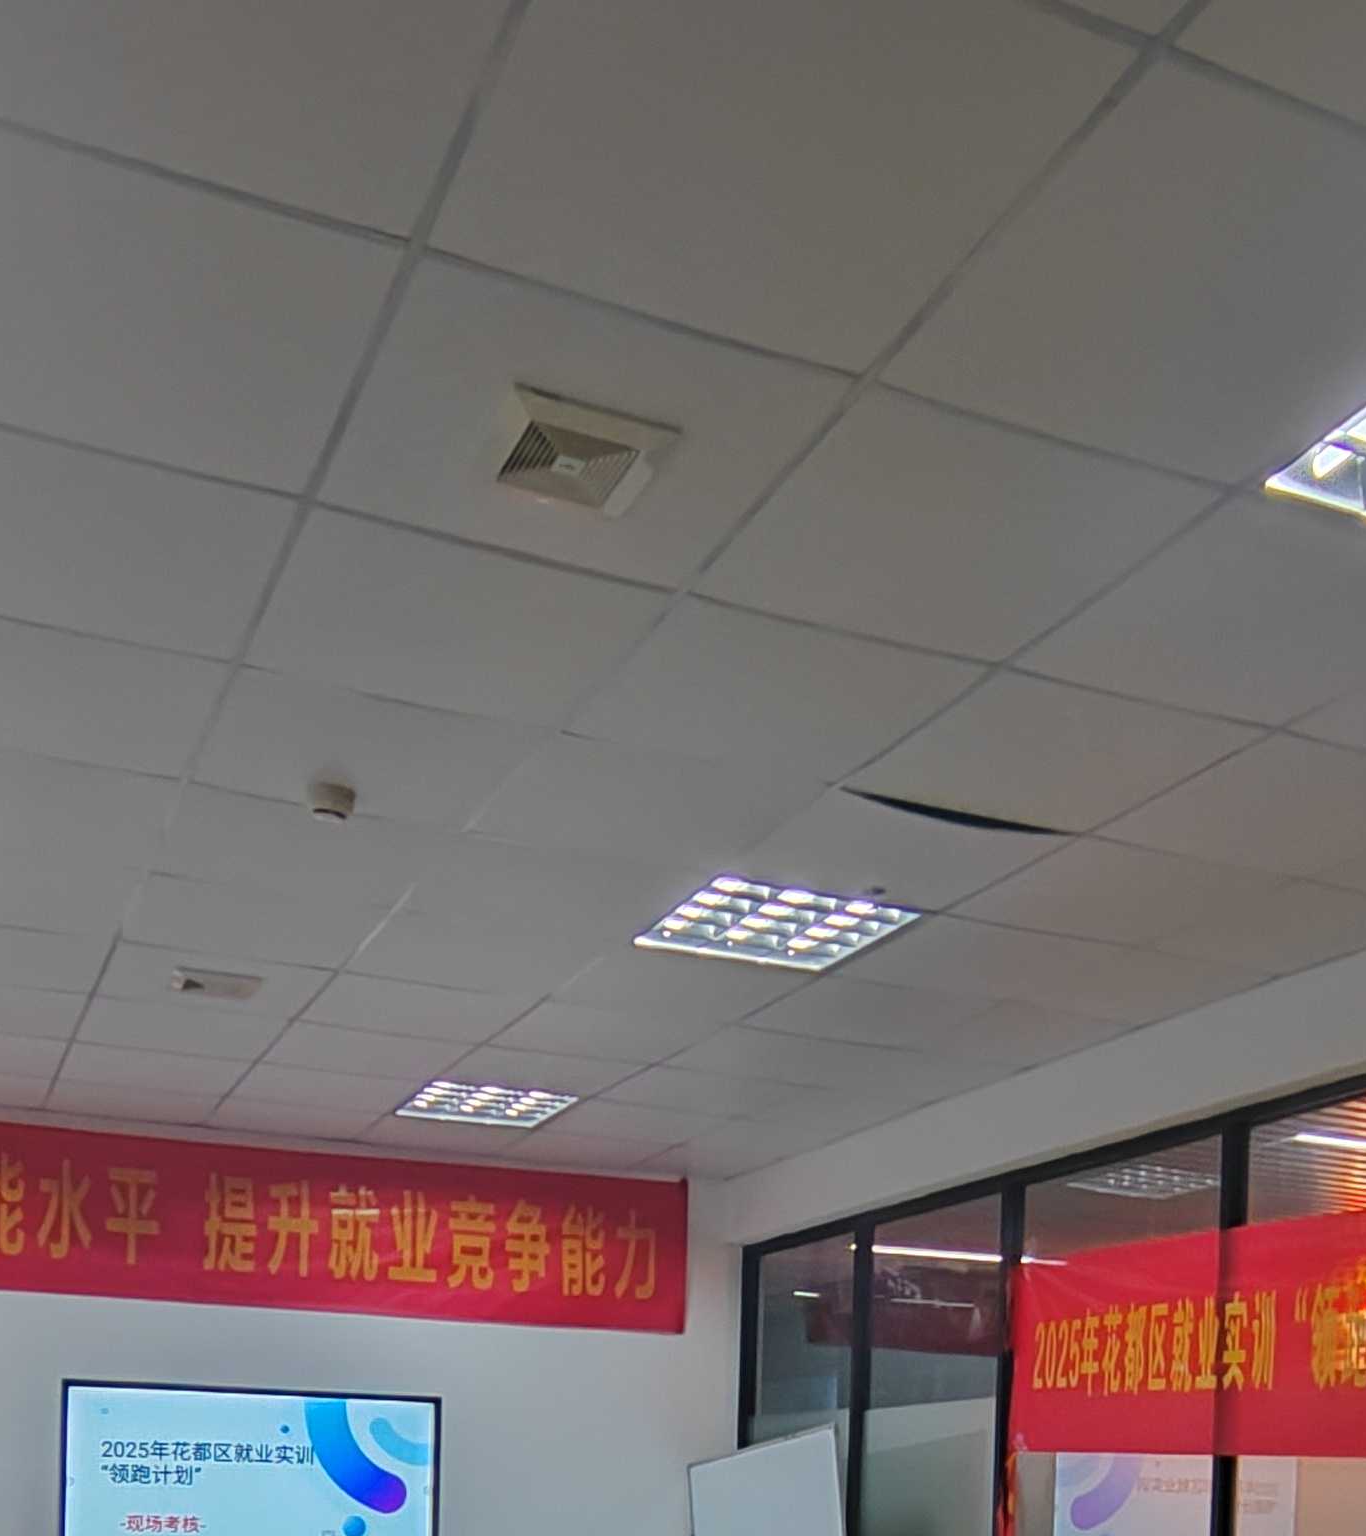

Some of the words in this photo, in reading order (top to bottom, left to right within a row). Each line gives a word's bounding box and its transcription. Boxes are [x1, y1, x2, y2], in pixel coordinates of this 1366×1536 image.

[202, 1173, 657, 1299] 提升就业竞争能力
[101, 1440, 315, 1466] 2025年花都区就业实训
[120, 1515, 206, 1533] -现场考核-
